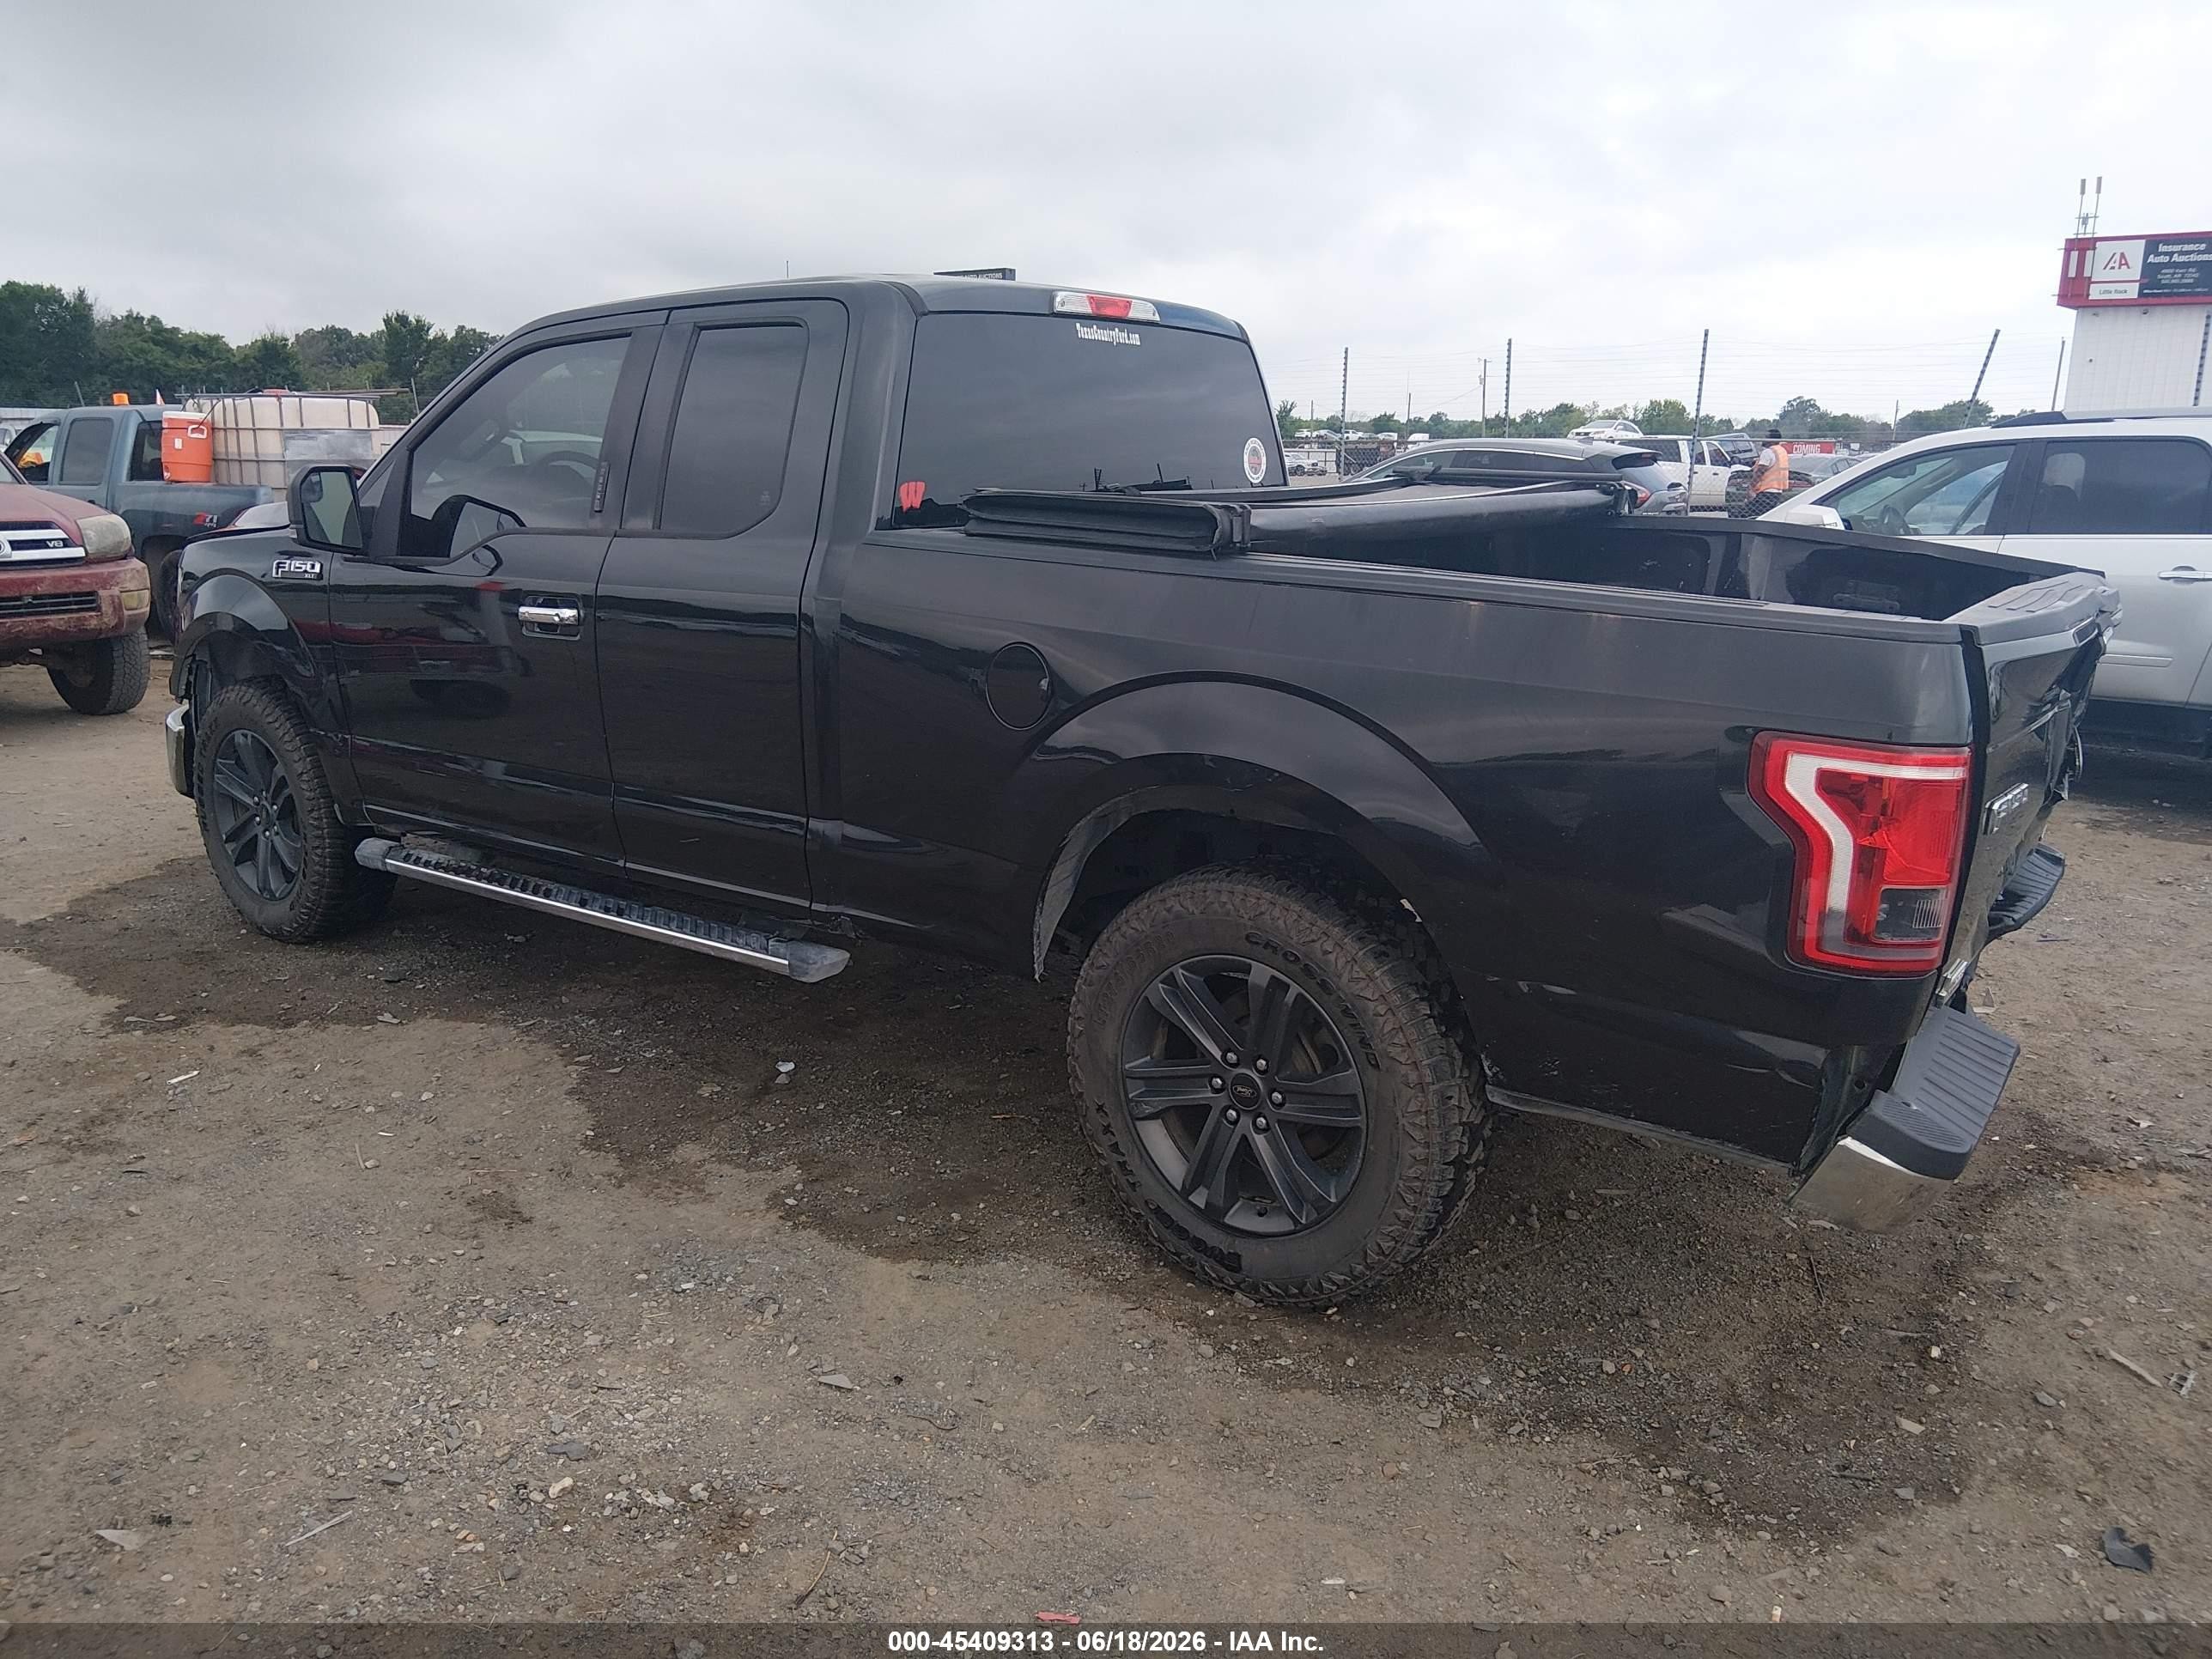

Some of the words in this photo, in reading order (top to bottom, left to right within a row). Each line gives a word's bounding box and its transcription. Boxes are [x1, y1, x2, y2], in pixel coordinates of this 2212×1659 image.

[2158, 243, 2207, 252] Insurance
[2146, 254, 2169, 264] Auto
[1075, 322, 1141, 346] TexasCountryFord.com
[1792, 444, 1821, 454] COMING
